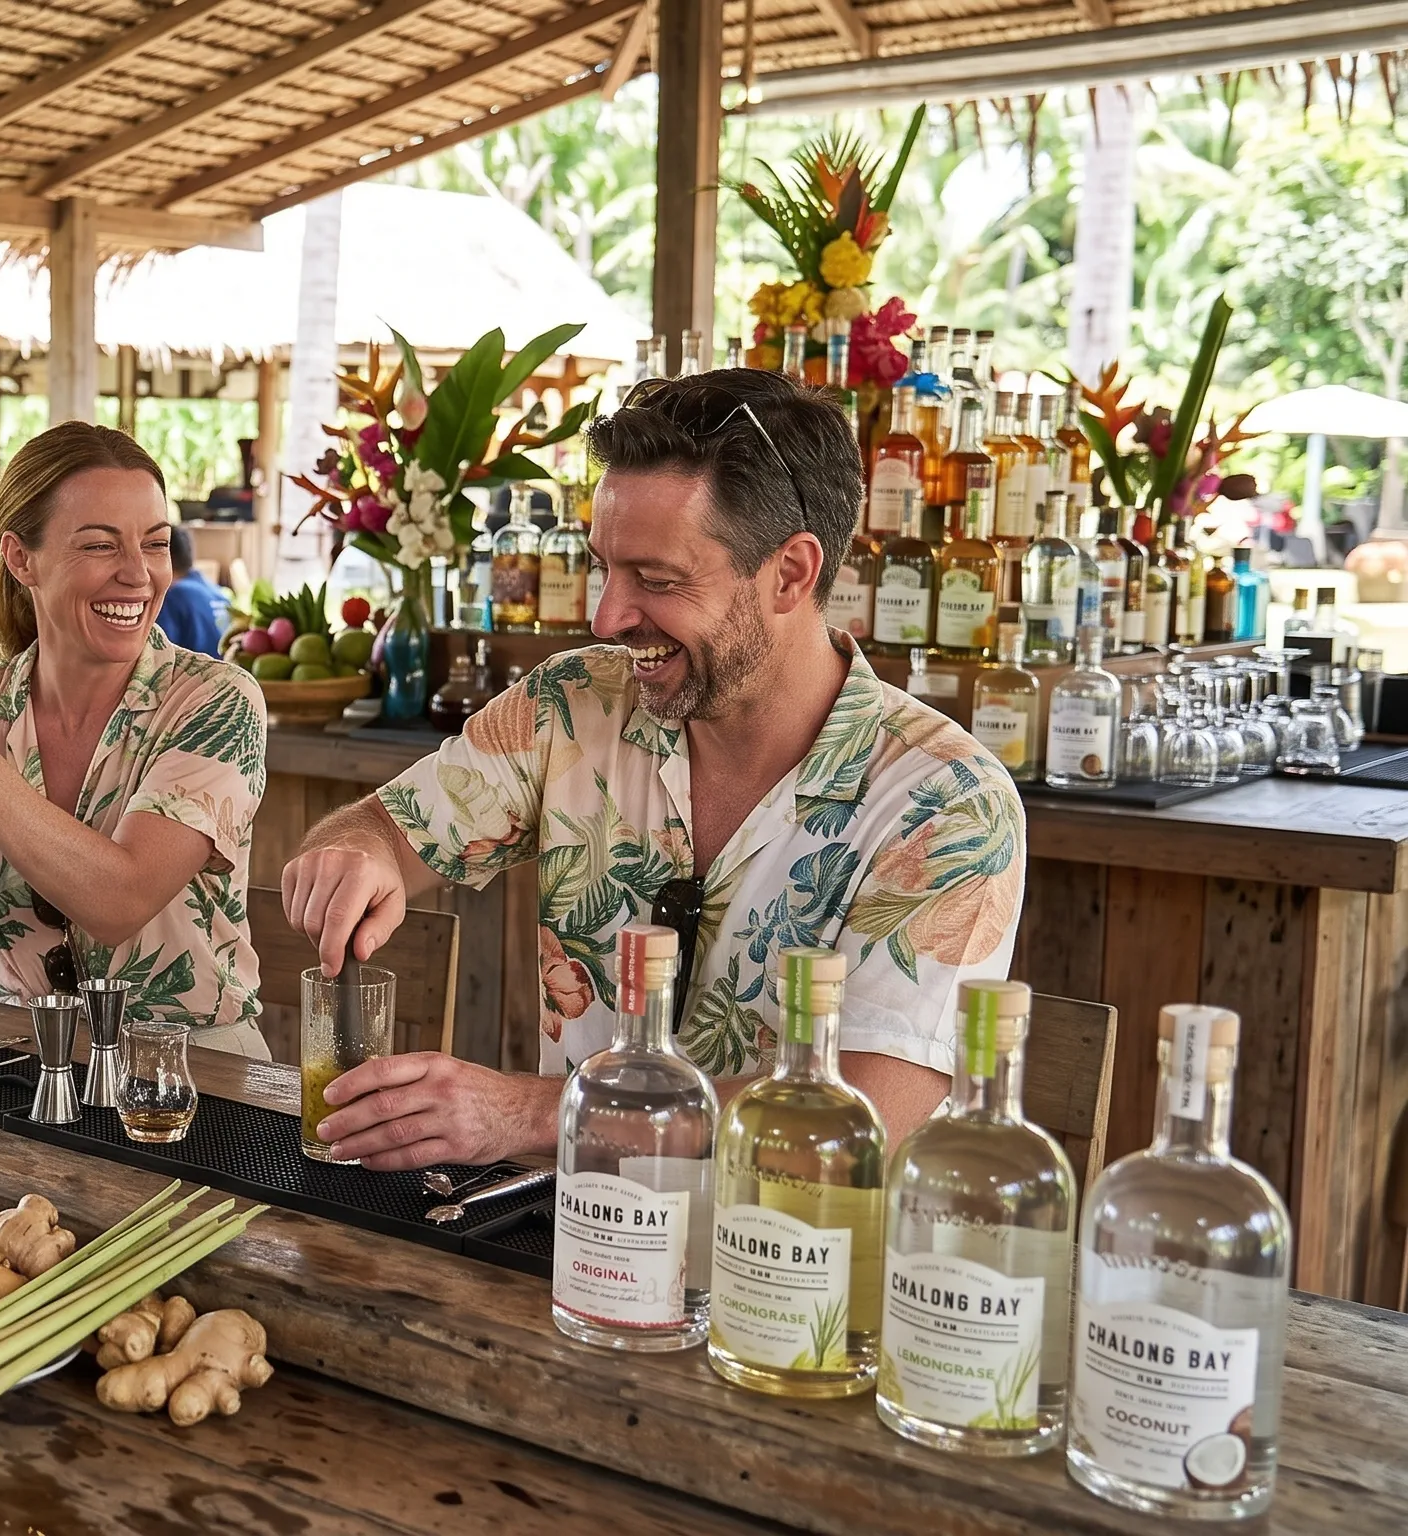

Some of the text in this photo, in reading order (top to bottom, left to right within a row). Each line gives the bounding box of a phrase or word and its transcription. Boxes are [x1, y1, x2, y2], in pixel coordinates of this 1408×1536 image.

[561, 1190, 623, 1223] CHALONG
[634, 1209, 668, 1227] BAY
[717, 1224, 781, 1260] CHALONG
[792, 1246, 830, 1264] BAY
[572, 1260, 638, 1283] ORIGINAL
[892, 1272, 968, 1311] CHALONG
[980, 1297, 1021, 1316] BAY
[1088, 1321, 1175, 1365] CHALONG
[1188, 1349, 1232, 1371] BAY
[1105, 1405, 1191, 1437] COCONUT
